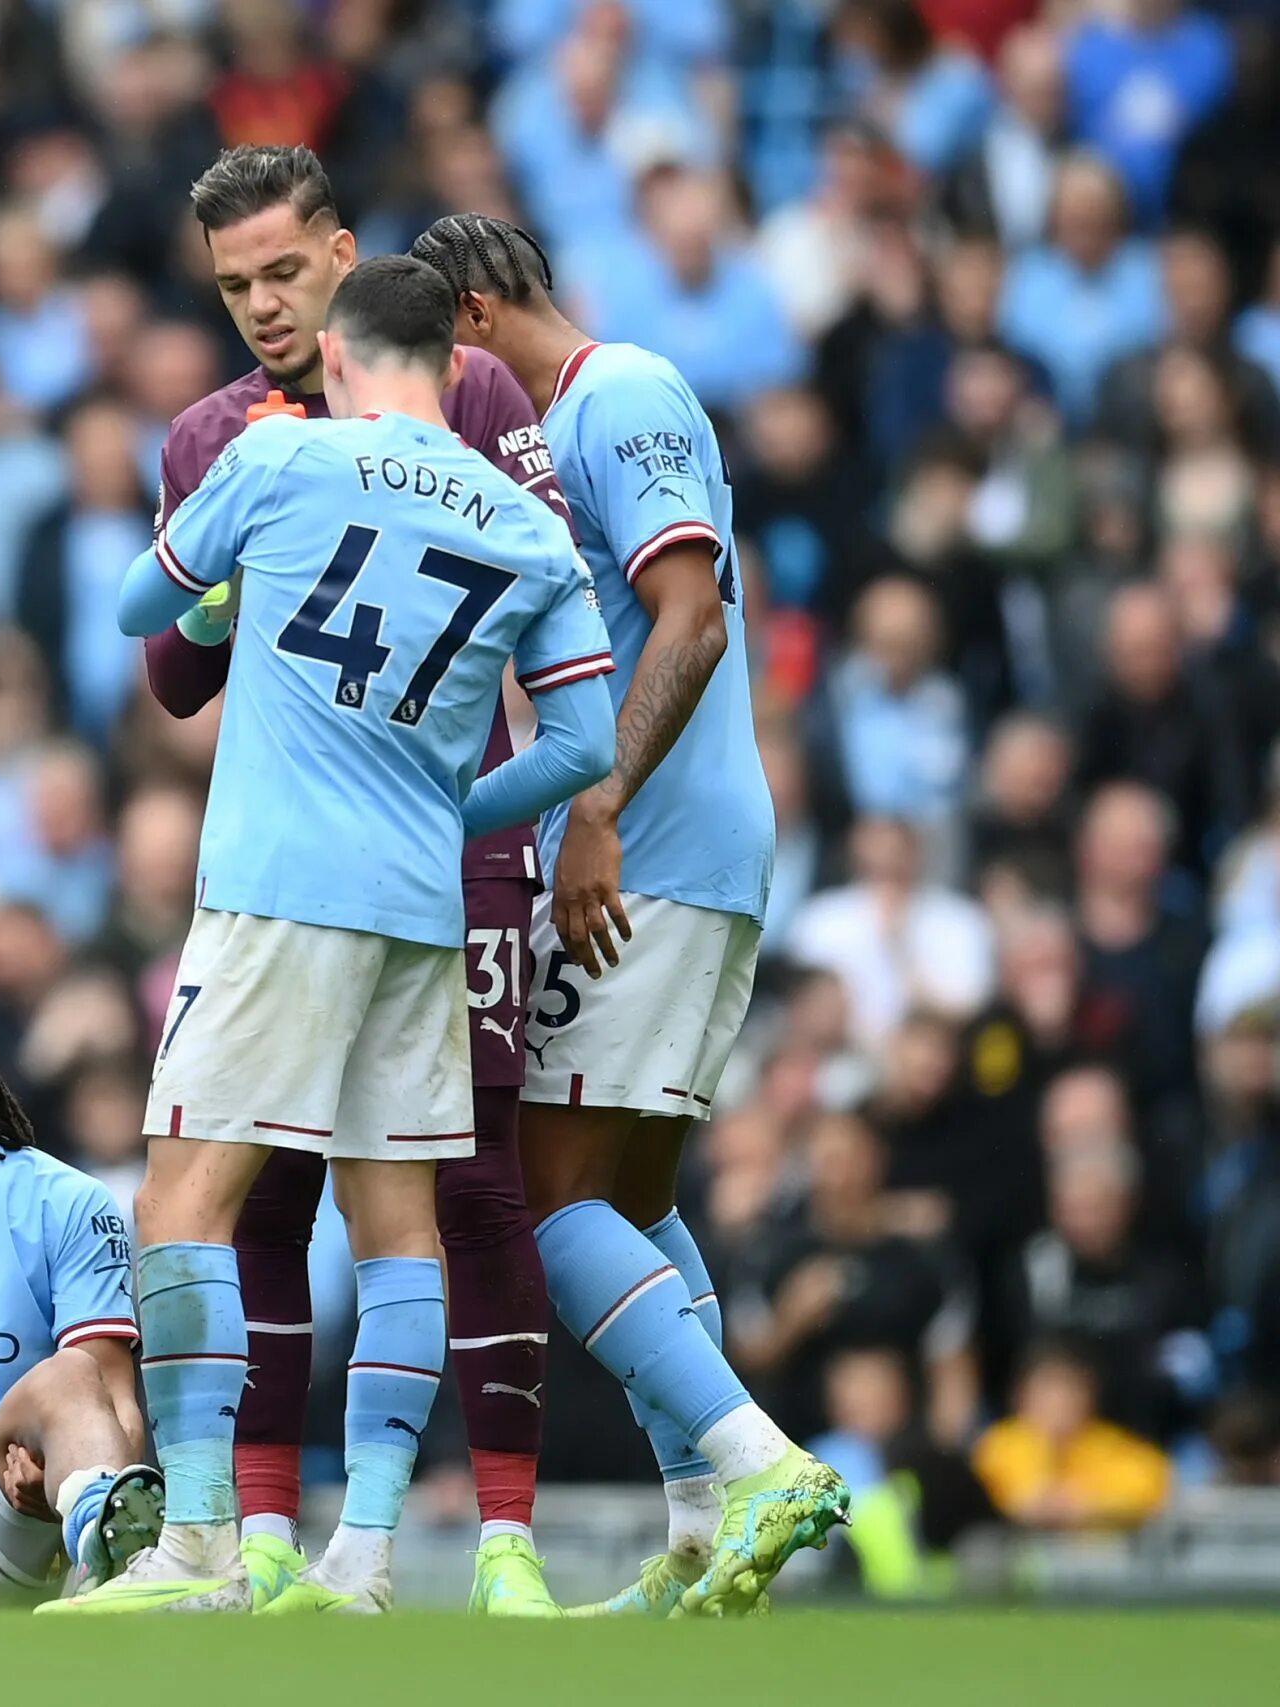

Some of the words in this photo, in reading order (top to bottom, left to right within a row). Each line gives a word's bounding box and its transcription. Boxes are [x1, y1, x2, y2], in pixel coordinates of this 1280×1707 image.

[614, 431, 692, 463] NEXEN
[636, 454, 689, 477] TIRE
[355, 455, 496, 532] FODEN
[275, 523, 519, 727] 47
[467, 927, 520, 1009] 31
[159, 985, 202, 1060] 7
